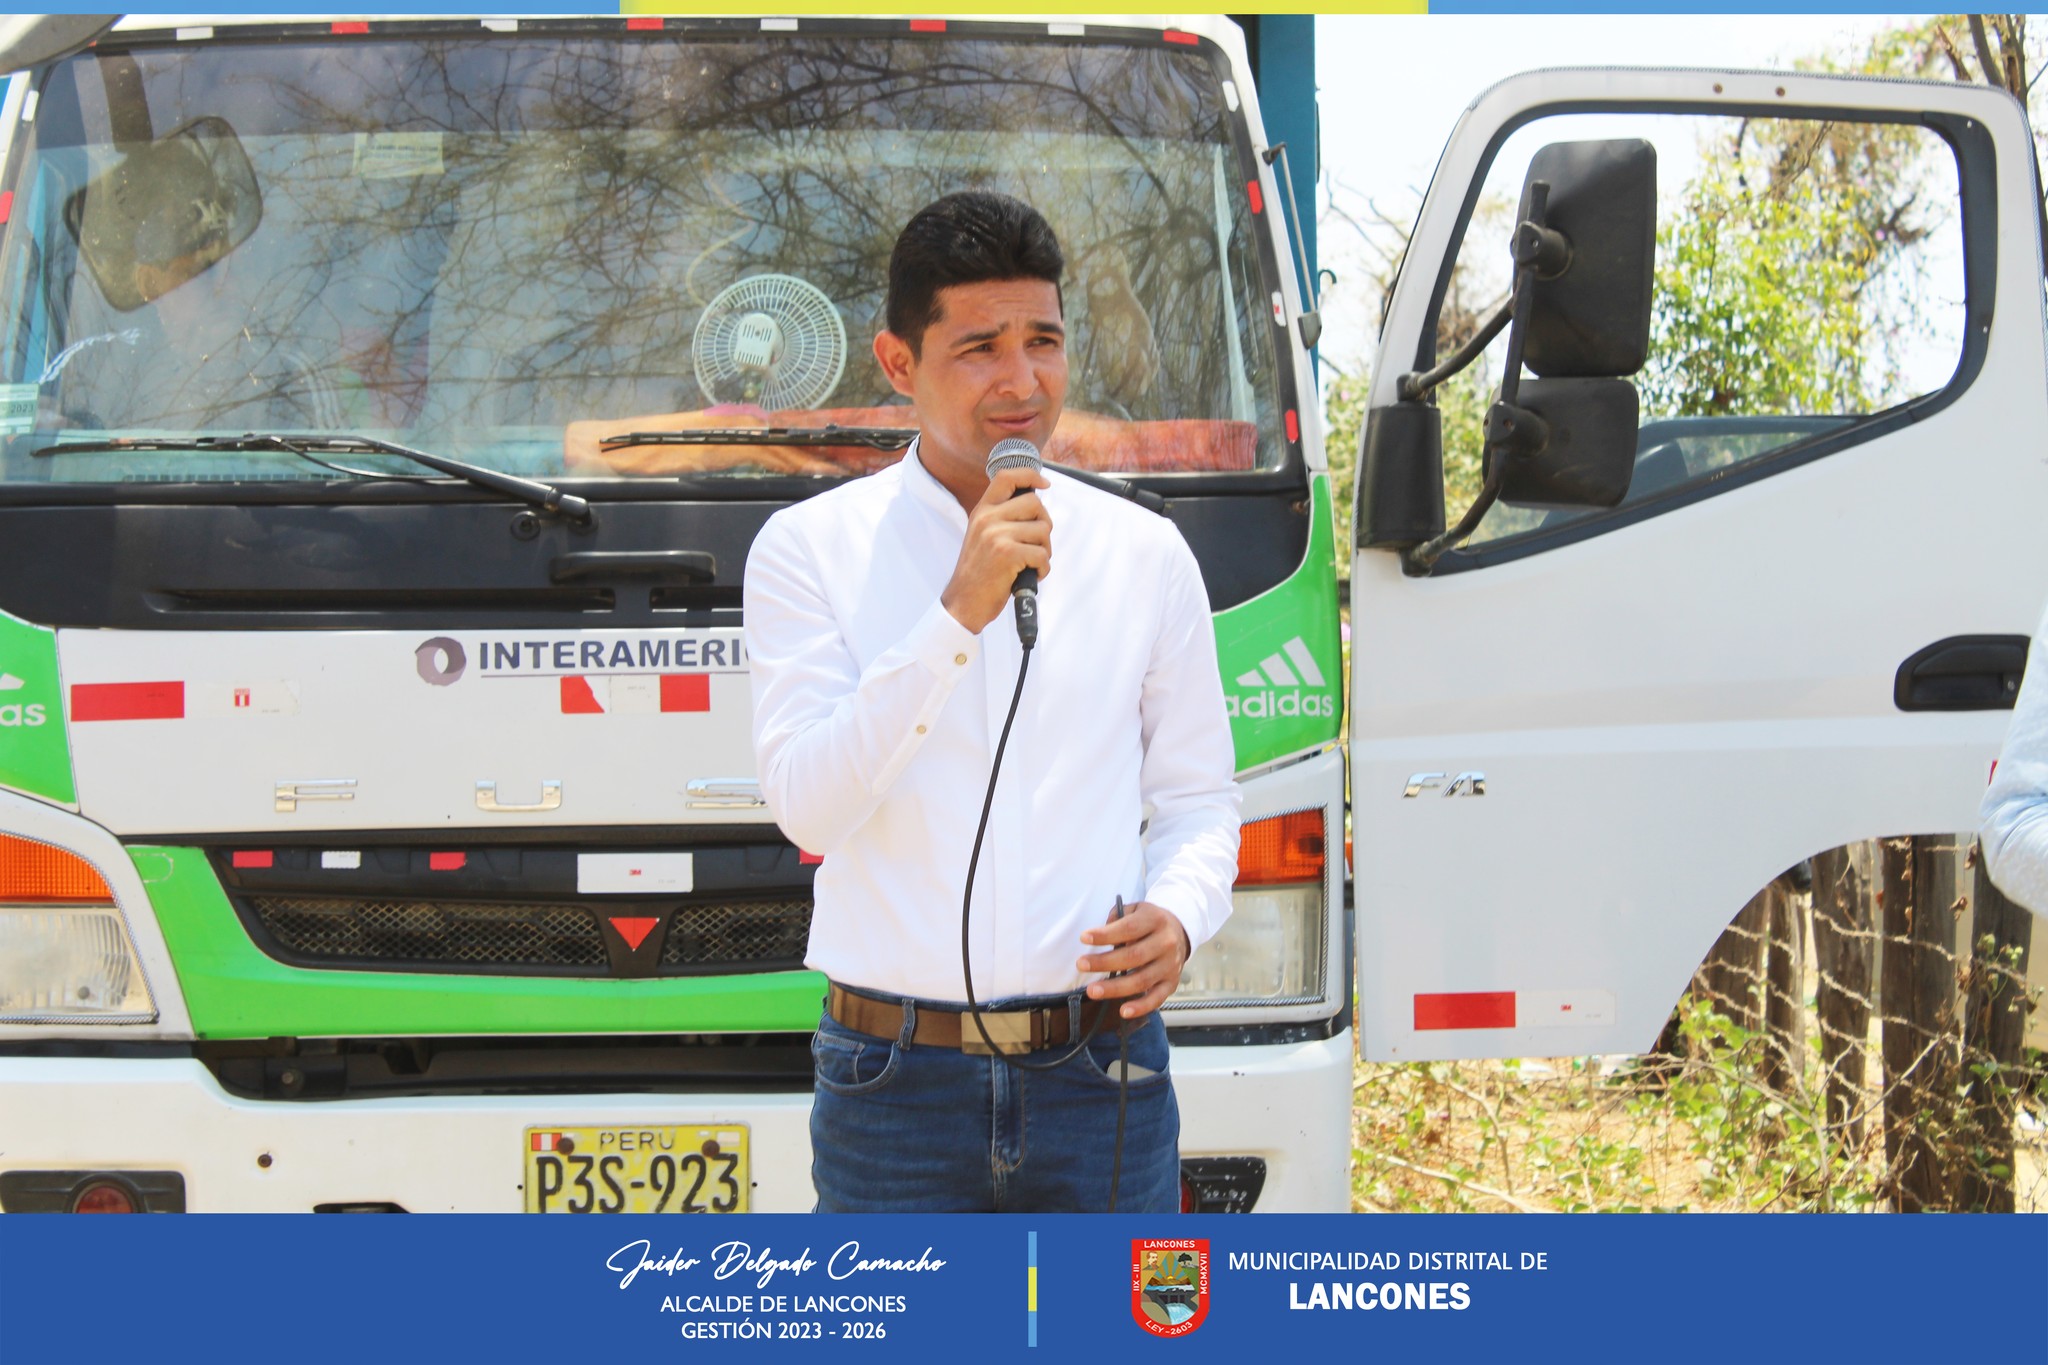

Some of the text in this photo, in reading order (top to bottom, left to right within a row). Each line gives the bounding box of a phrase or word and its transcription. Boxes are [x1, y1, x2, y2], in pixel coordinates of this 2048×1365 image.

[479, 638, 749, 670] INTERAMERI
[1223, 689, 1334, 718] adidas
[600, 1131, 675, 1151] PERU
[536, 1153, 739, 1213] P3S-923
